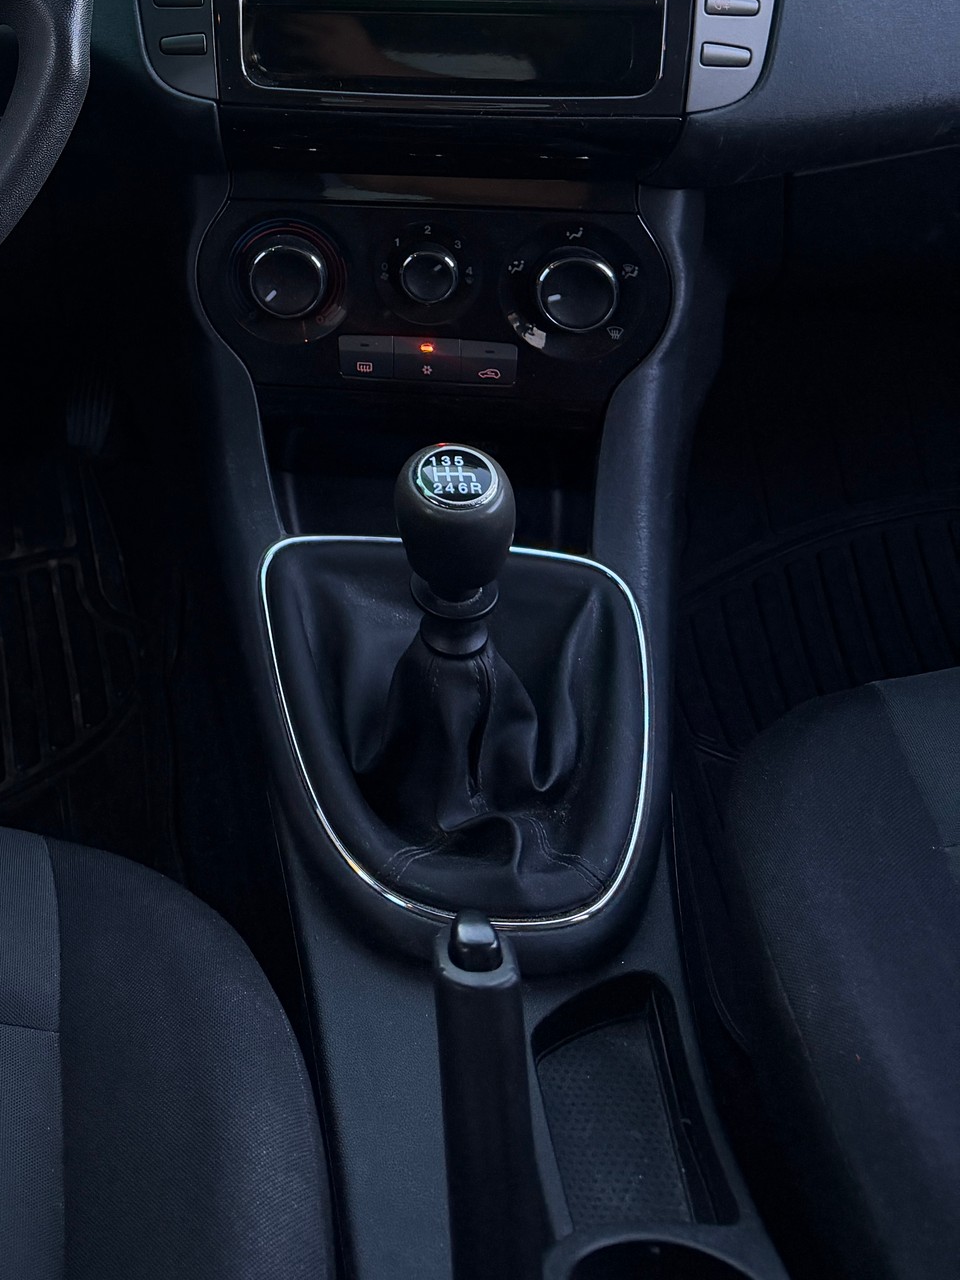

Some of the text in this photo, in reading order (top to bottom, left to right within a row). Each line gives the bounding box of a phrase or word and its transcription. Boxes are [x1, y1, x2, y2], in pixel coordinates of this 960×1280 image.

[424, 225, 432, 235] 2
[394, 238, 400, 247] 1
[454, 240, 462, 249] 3
[465, 266, 473, 275] 4
[429, 455, 464, 466] 1 3 5
[433, 482, 482, 494] 2 4 6 R
